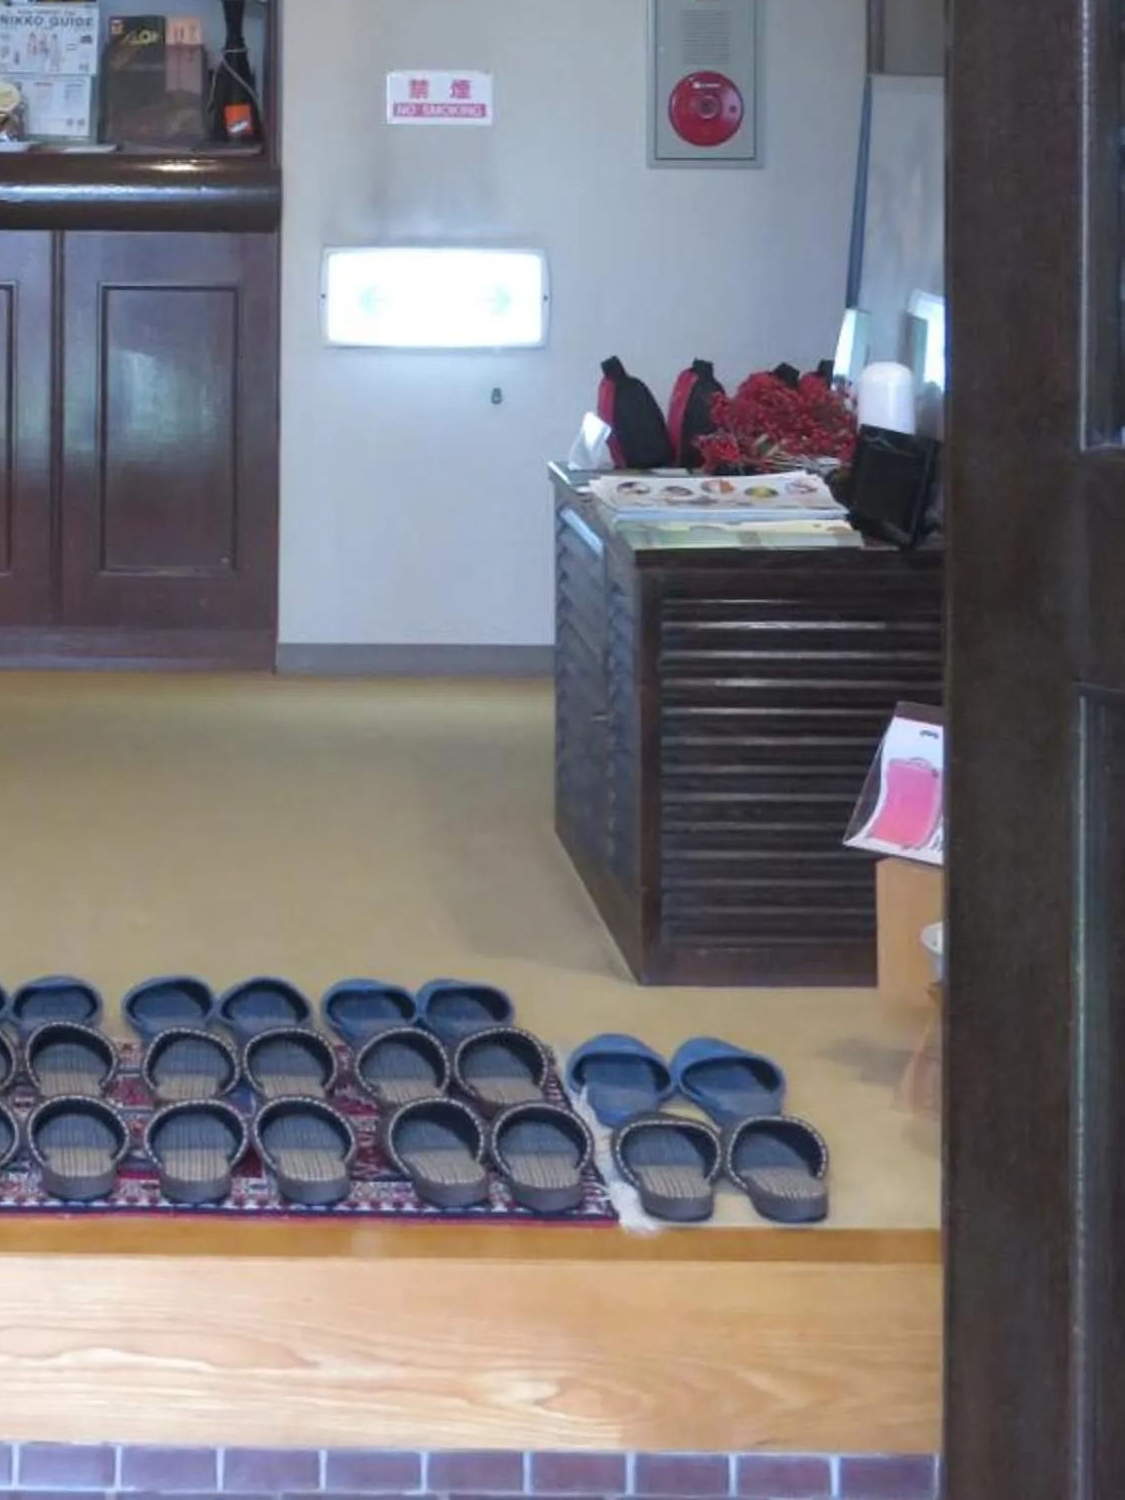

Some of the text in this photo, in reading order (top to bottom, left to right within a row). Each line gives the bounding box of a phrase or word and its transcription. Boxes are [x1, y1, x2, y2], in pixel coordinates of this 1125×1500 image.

[0, 13, 93, 27] NIKKO GUIDE
[397, 104, 483, 117] NO SMOKING
